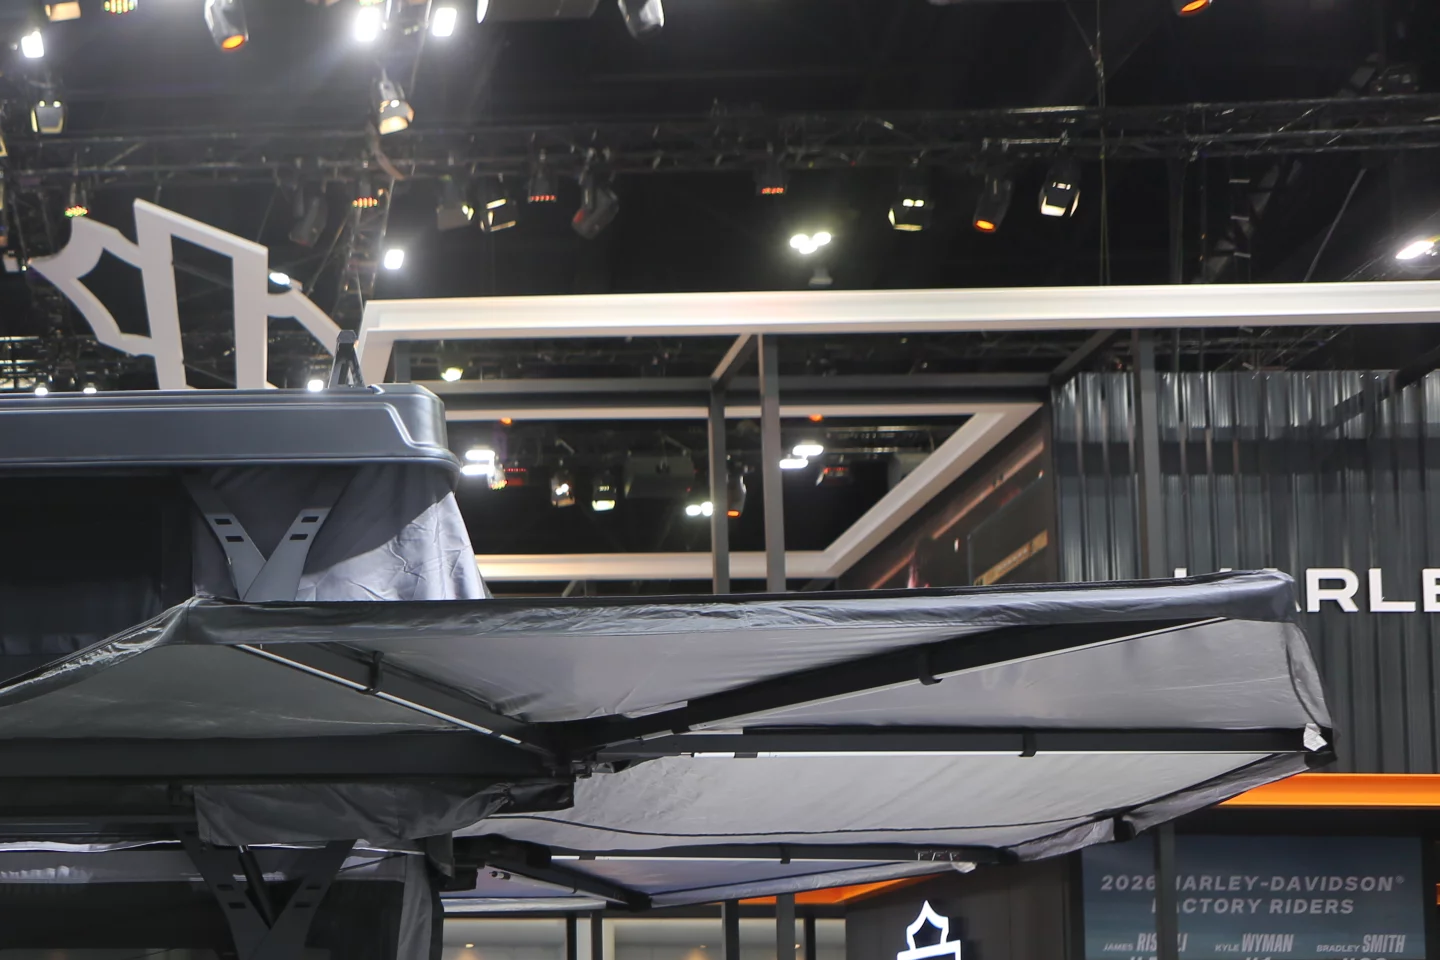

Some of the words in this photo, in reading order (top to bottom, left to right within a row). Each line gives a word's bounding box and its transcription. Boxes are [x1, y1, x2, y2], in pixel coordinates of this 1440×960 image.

[1100, 875, 1156, 891] 2026
[1152, 898, 1262, 914] CTORY
[1269, 899, 1355, 914] RIDERS
[1241, 932, 1294, 952] WYMAN
[1316, 944, 1360, 953] BRADLEY
[1362, 933, 1406, 953] SMITH
